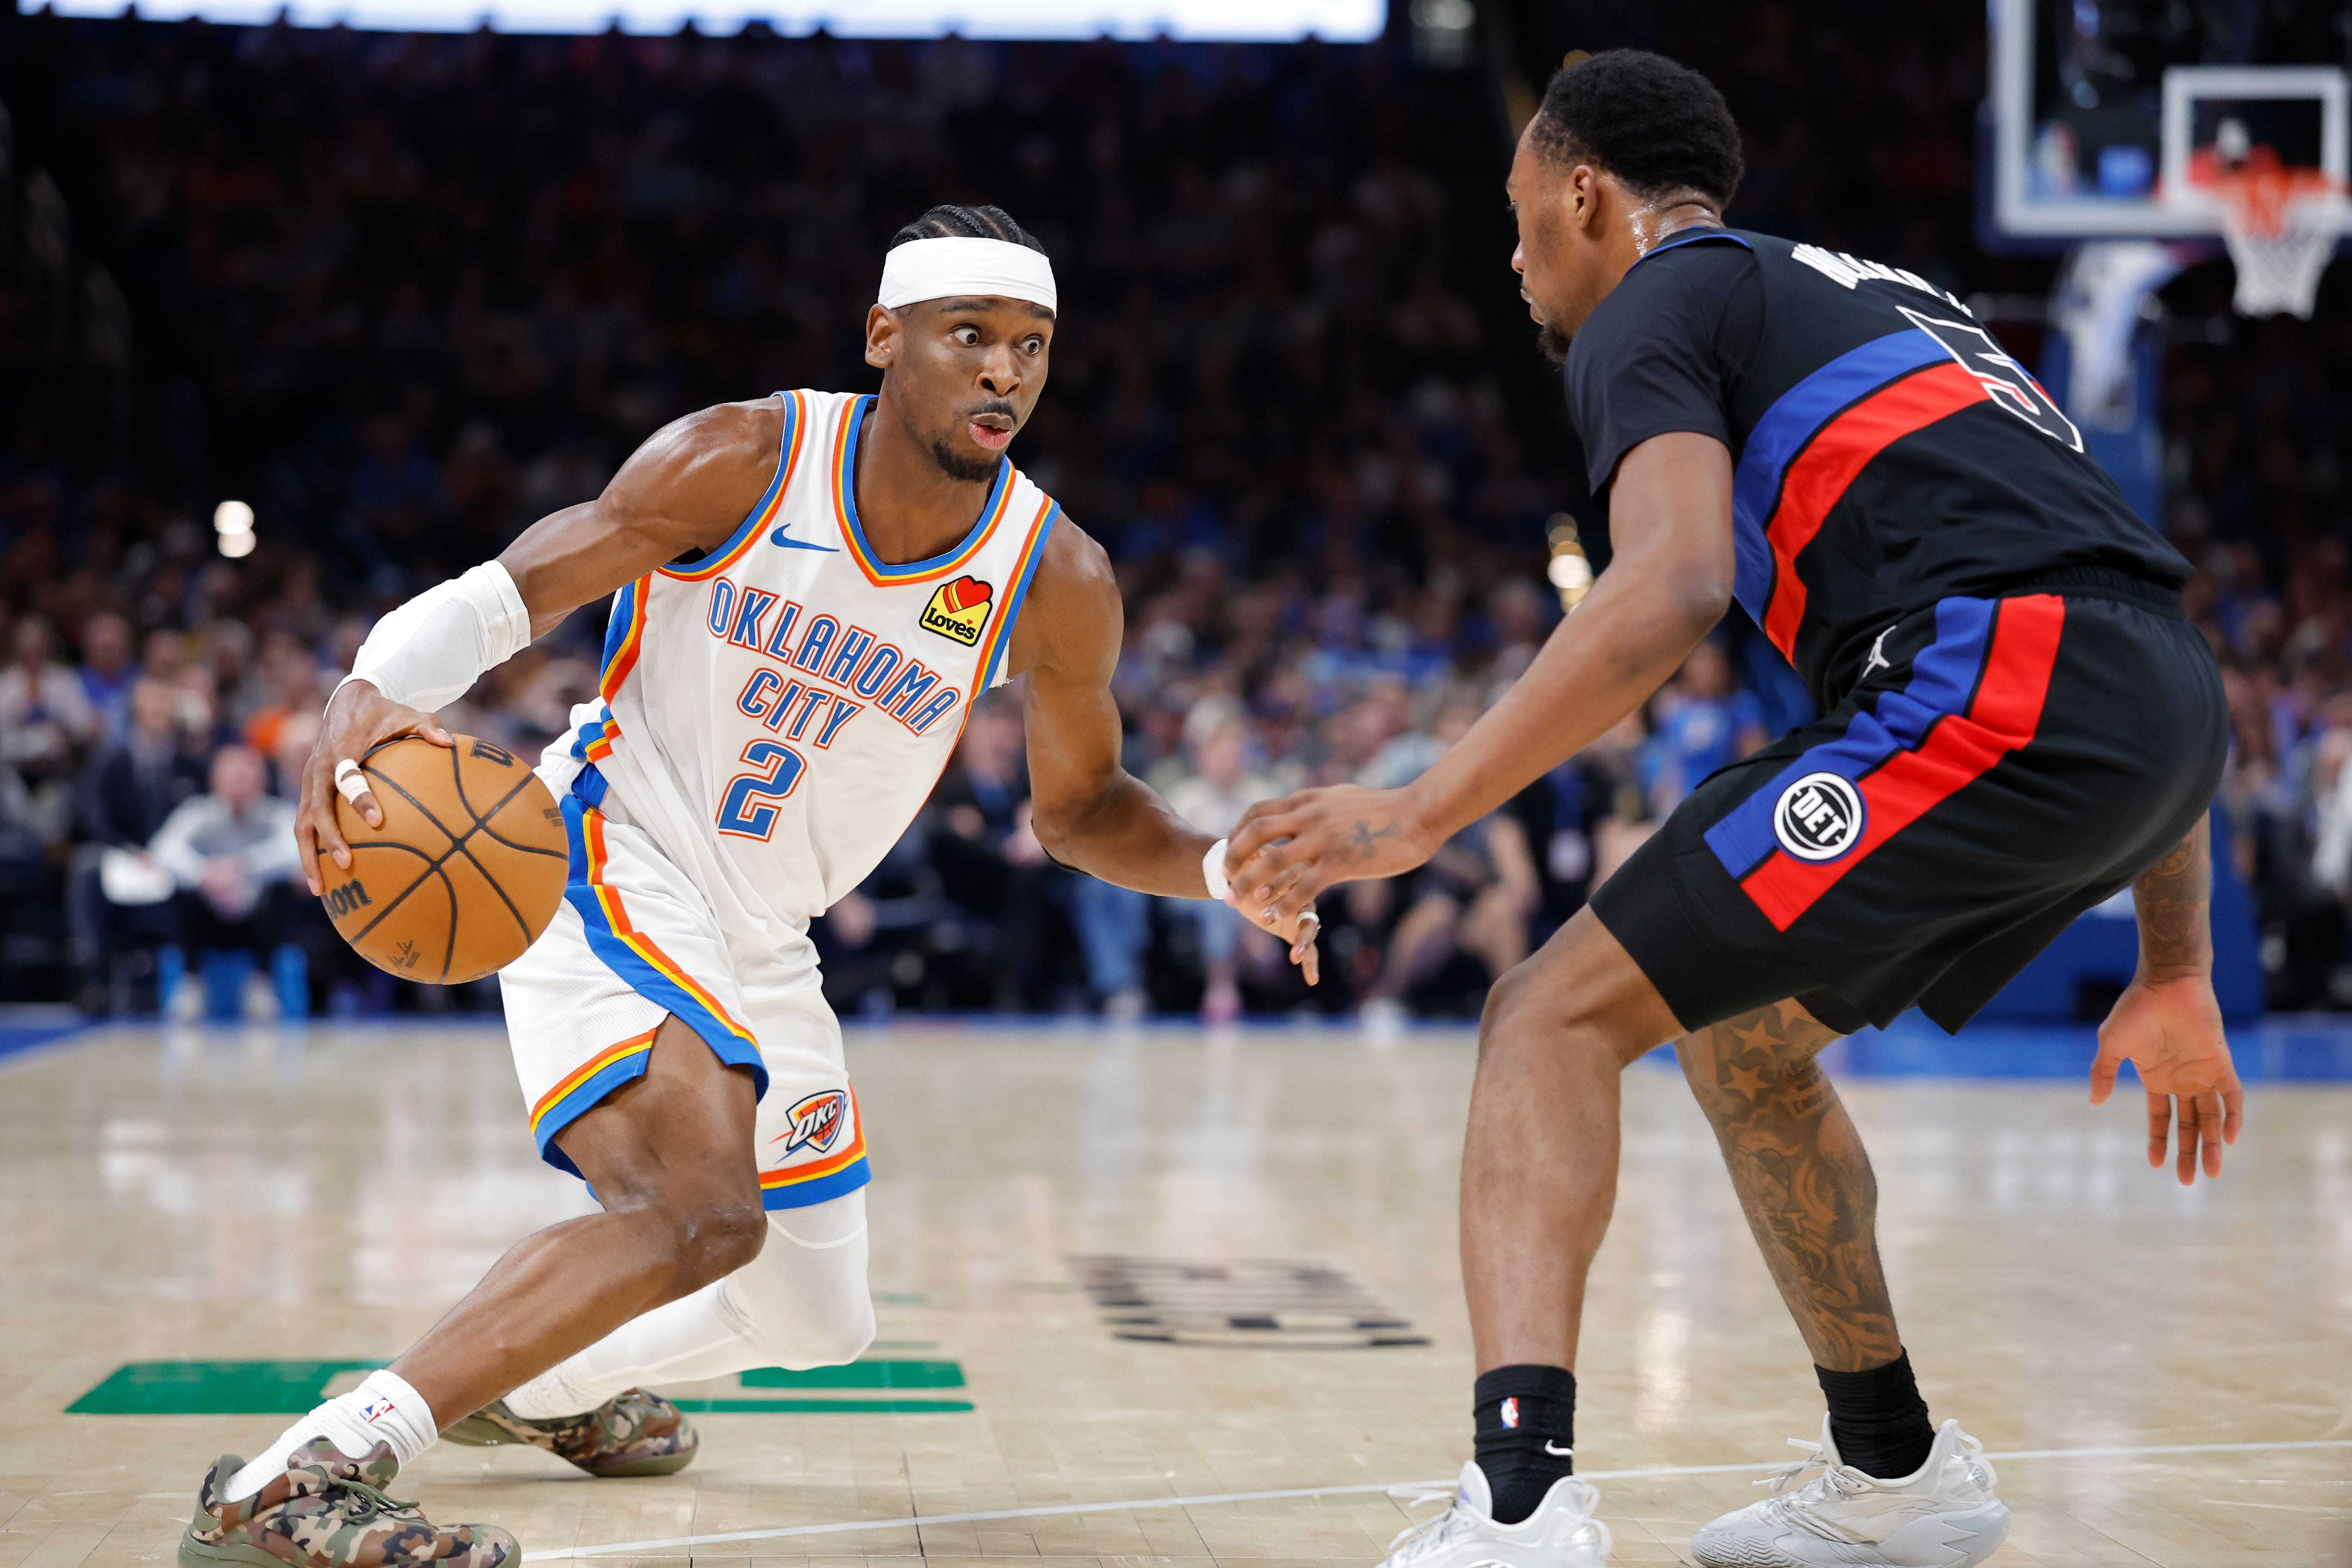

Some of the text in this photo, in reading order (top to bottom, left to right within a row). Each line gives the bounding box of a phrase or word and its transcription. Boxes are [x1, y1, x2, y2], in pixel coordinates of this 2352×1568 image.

[706, 576, 961, 737] OKLAHOMA
[736, 667, 865, 750] CITY
[715, 738, 807, 842] 2
[1791, 785, 1847, 843] DET
[786, 1096, 837, 1151] OKC
